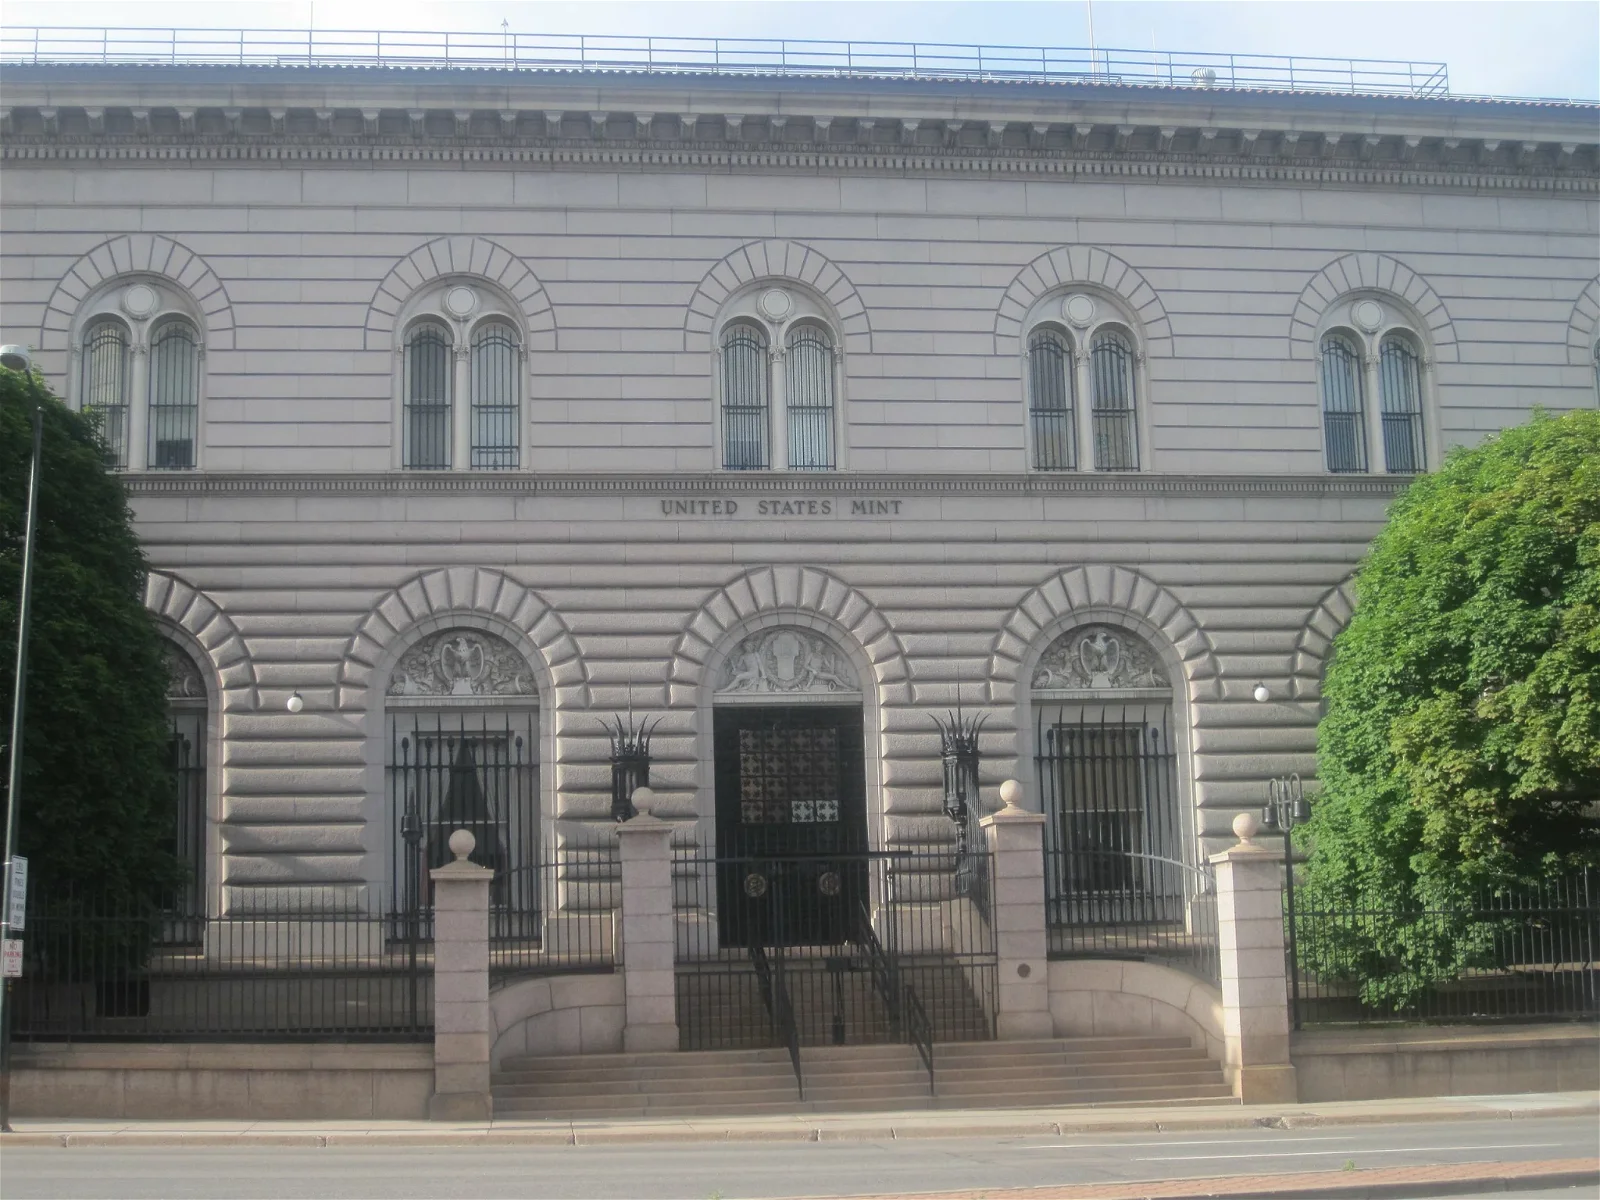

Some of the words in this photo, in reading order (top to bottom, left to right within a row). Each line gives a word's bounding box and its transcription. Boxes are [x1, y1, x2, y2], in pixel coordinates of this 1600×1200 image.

[661, 499, 738, 515] UNITED
[758, 499, 831, 515] STATES
[850, 499, 902, 515] MINT
